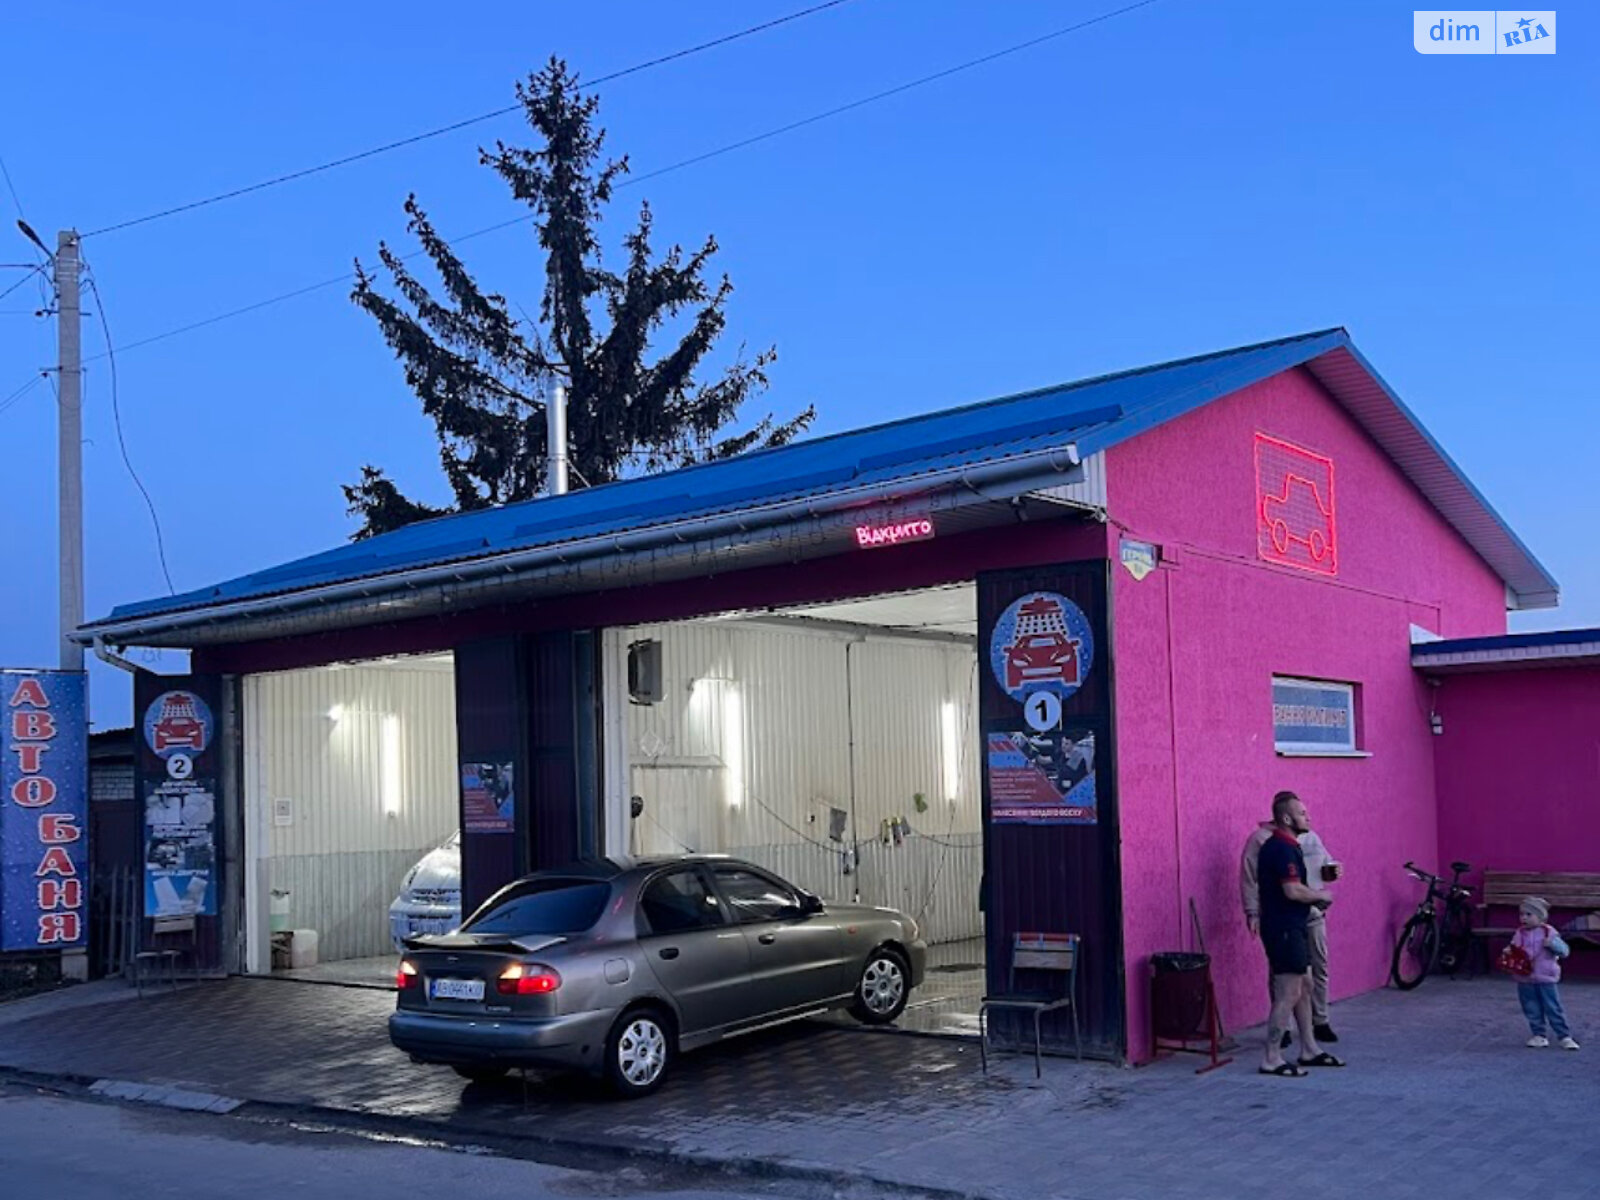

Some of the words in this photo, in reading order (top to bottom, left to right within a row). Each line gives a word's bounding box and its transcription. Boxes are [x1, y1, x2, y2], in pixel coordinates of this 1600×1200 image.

[1035, 699, 1047, 722] 1
[174, 759, 185, 773] 2
[9, 678, 57, 807] АВТО
[36, 813, 81, 943] БАНЯ
